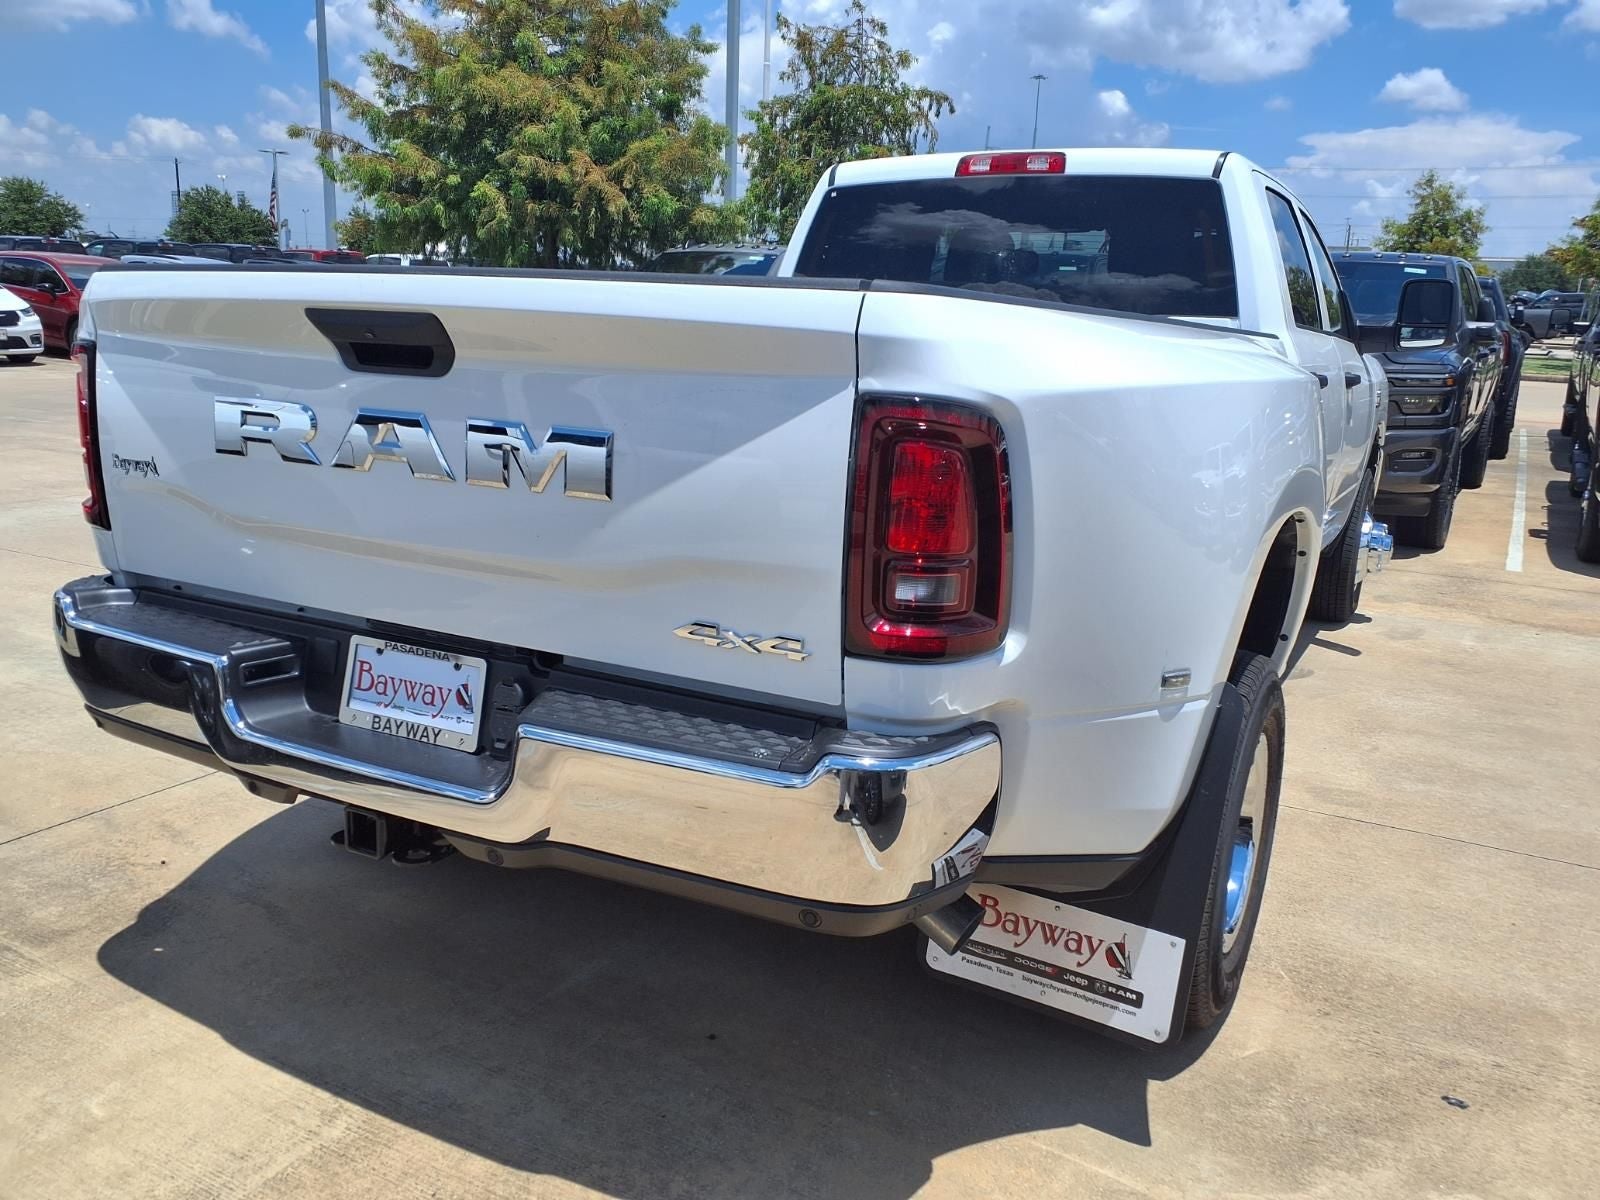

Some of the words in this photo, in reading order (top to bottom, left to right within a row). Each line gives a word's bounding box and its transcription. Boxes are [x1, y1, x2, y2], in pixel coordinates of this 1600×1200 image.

[214, 395, 614, 502] RAM
[384, 641, 451, 662] PASADENA
[354, 659, 452, 719] Bayway
[371, 715, 442, 744] BAYWAY
[978, 893, 1105, 968] Bayway
[961, 955, 994, 972] Pasadena,
[995, 966, 1015, 978] Texas
[1014, 956, 1053, 973] DODGE
[1063, 972, 1089, 987] Jeep
[1108, 986, 1137, 1001] RAM
